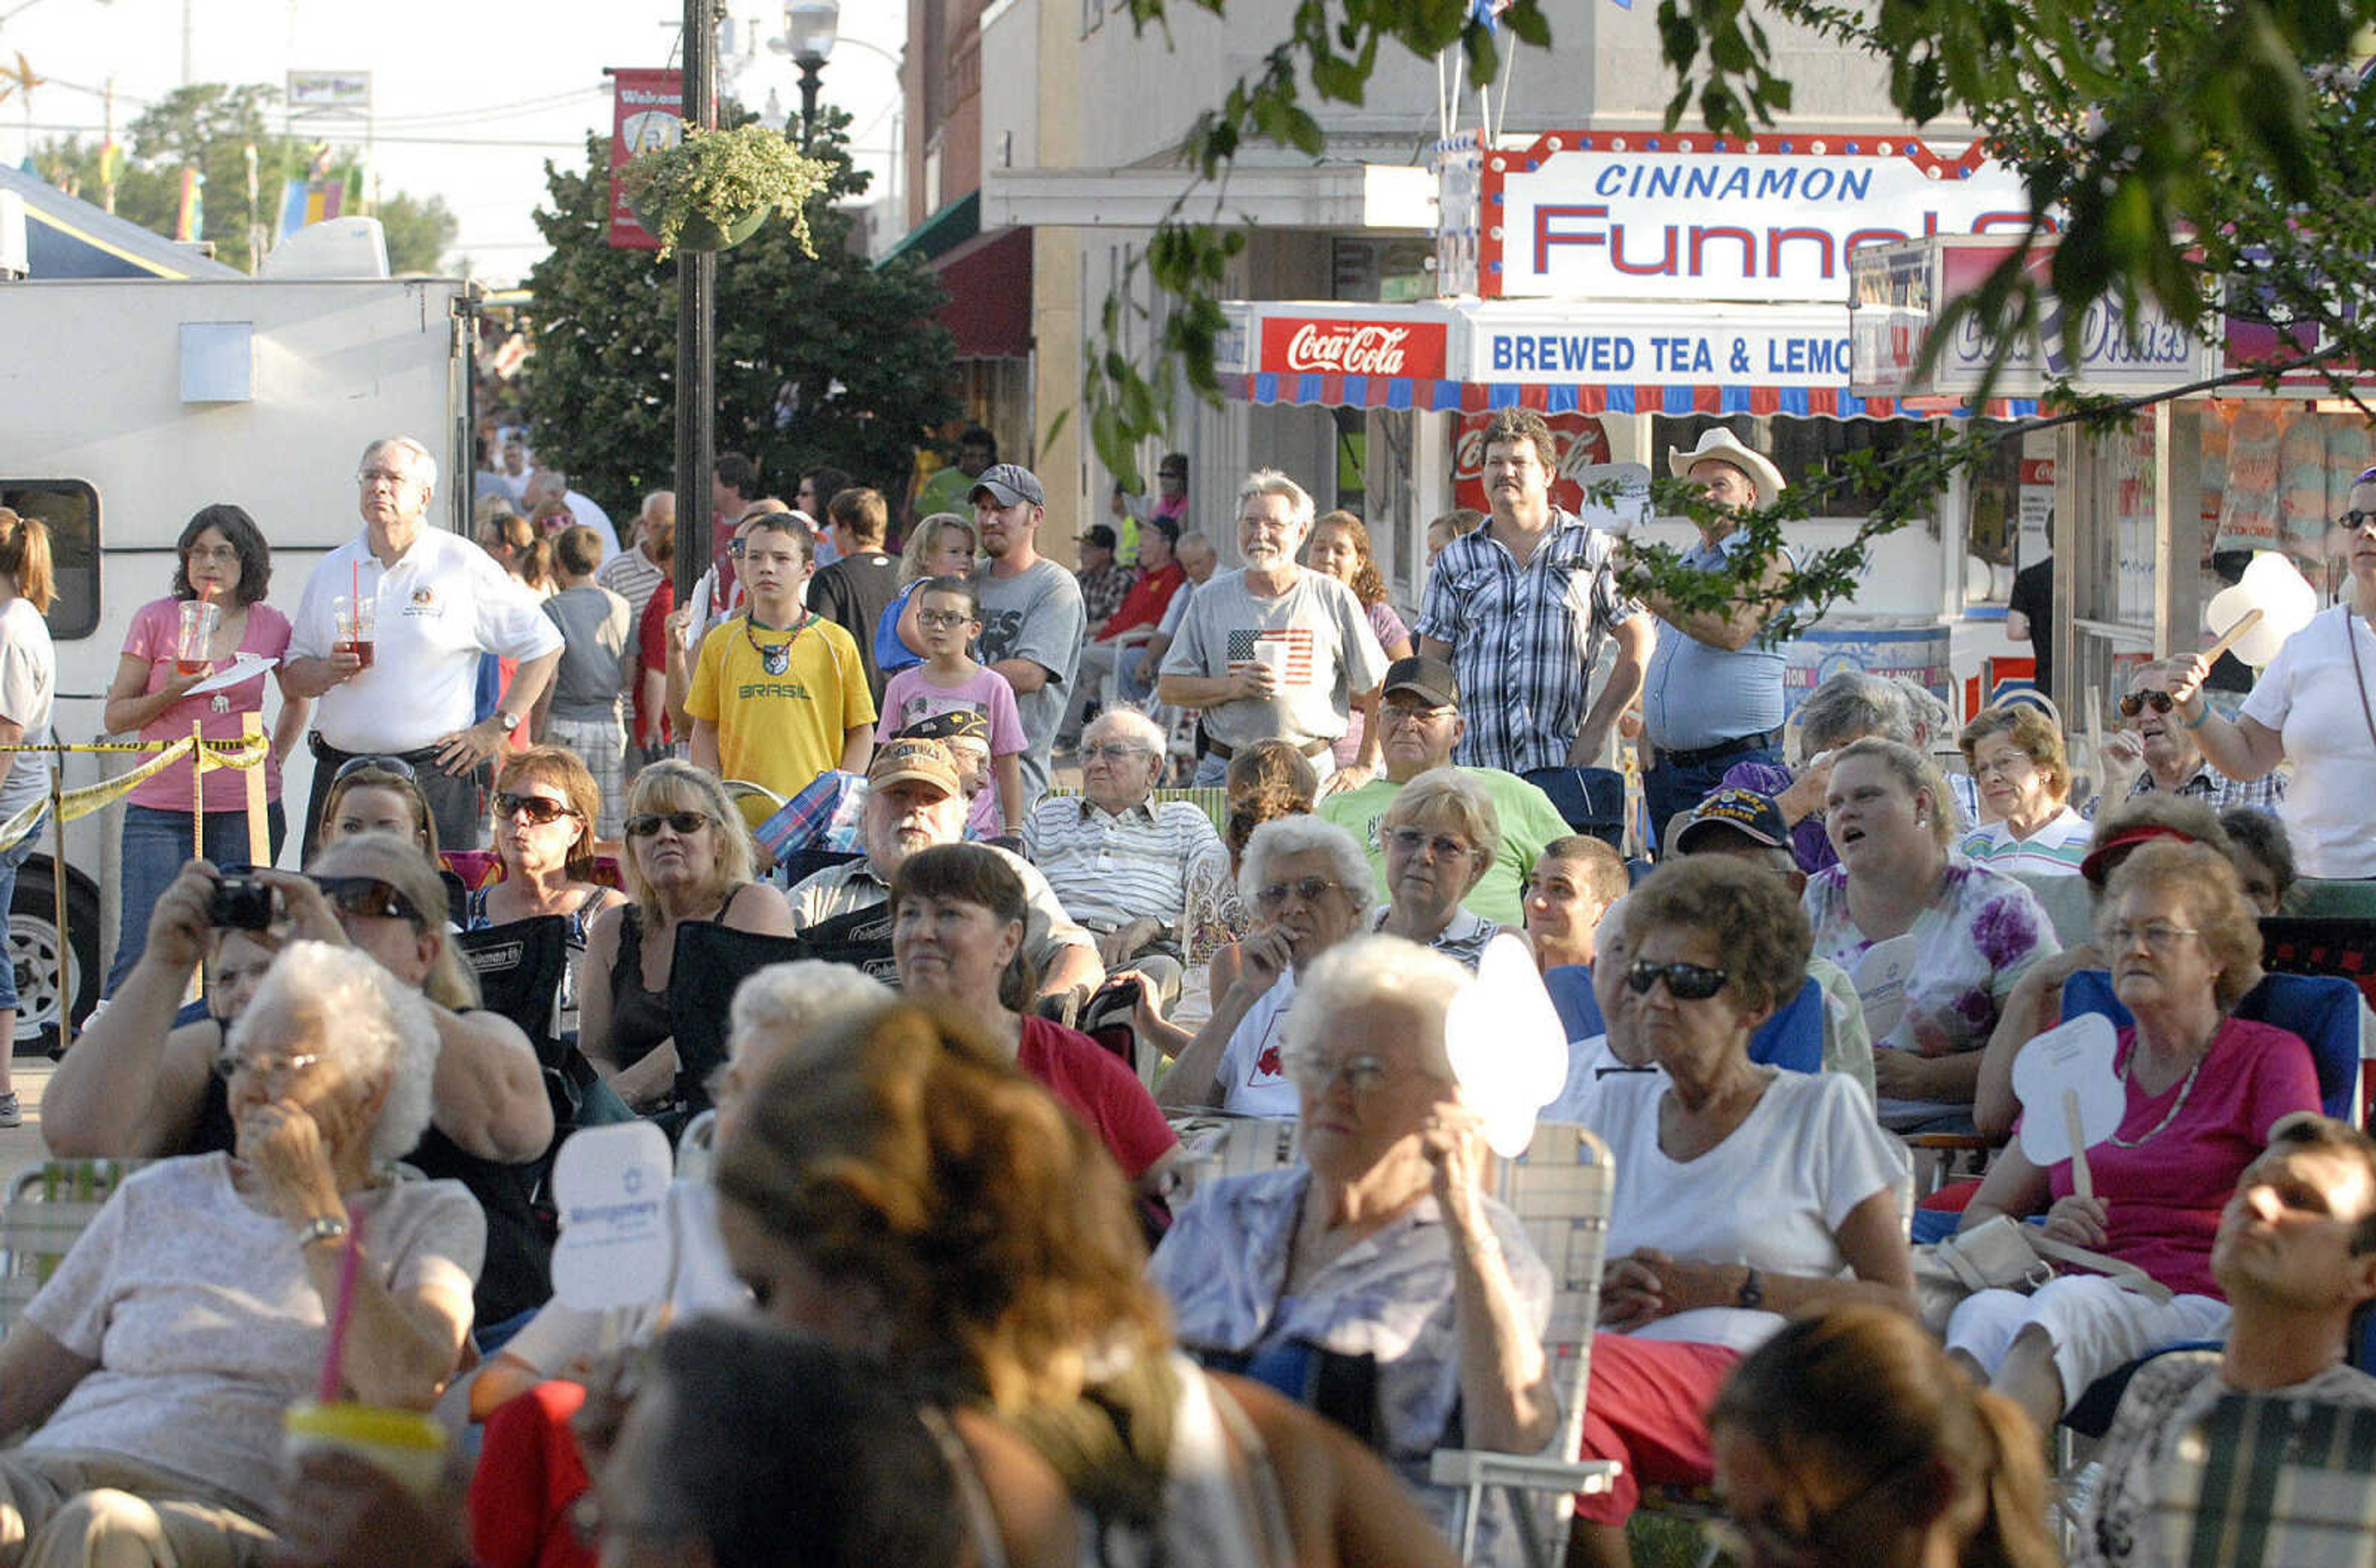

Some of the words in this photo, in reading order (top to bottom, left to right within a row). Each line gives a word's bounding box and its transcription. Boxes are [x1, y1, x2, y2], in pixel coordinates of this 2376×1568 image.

[621, 90, 682, 105] Welcom
[1595, 164, 1873, 201] CINNAMON
[1288, 323, 1411, 375] Coca-Cola
[1492, 335, 1635, 371] BREWED
[1650, 337, 1714, 372] TEA
[1730, 337, 1750, 373] &
[739, 683, 811, 700] BRASIL
